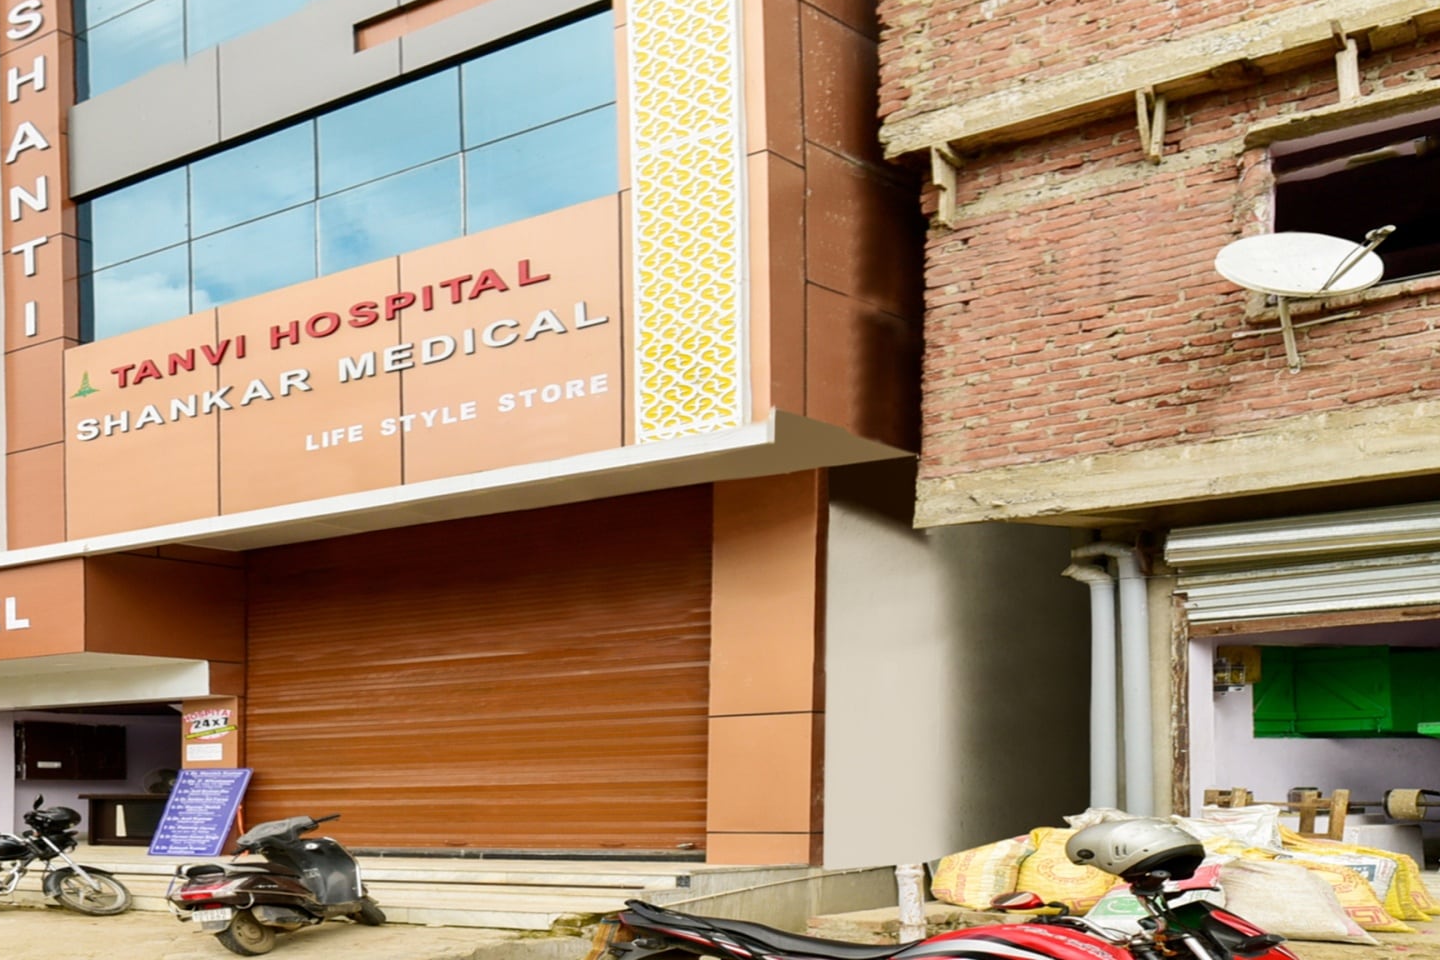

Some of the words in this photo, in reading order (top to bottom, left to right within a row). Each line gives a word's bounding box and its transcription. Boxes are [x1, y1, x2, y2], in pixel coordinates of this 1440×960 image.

[76, 367, 311, 444] SHANKAR
[338, 300, 608, 383] MEDICAL
[111, 335, 246, 389] TANVI
[269, 259, 551, 350] HOSPITAL
[305, 424, 363, 451] LIFE
[380, 401, 477, 436] STYLE
[497, 374, 609, 414] STORE
